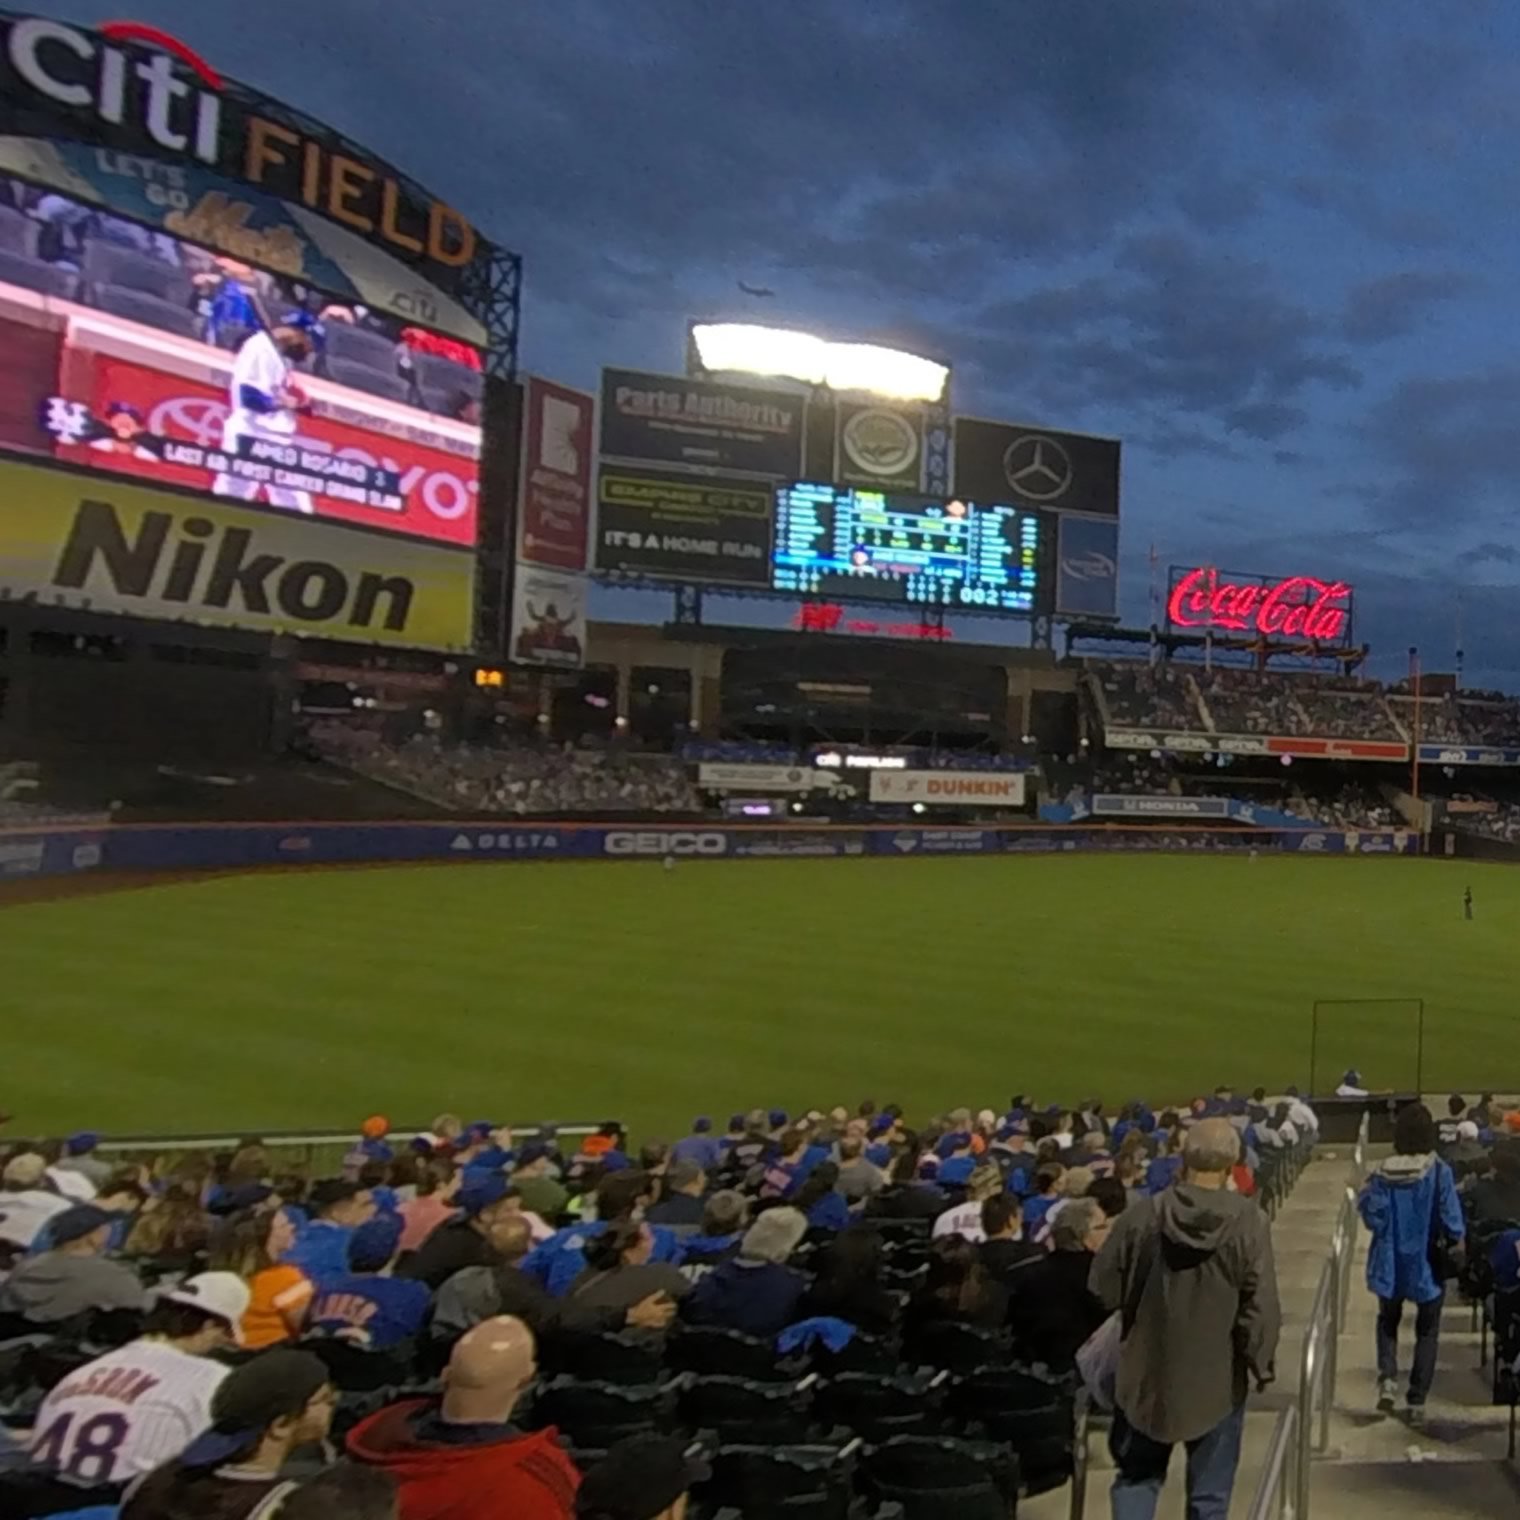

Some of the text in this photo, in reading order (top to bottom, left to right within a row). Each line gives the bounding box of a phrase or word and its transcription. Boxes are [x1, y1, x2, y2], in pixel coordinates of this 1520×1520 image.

[9, 19, 474, 267] citi FIELD
[97, 149, 186, 187] LET'S
[146, 182, 190, 209] GO
[615, 386, 793, 428] Parts Authority
[233, 459, 271, 482] FIRST
[301, 453, 367, 483] ROSARIO
[604, 530, 762, 559] IT'S A HOME RUN
[53, 499, 414, 633] Nikon
[1168, 566, 1353, 640] Coca-Cola
[926, 778, 1017, 797] DUNKIN'
[1138, 801, 1200, 812] HONDA
[478, 833, 559, 850] DELTA
[603, 831, 727, 855] GEICO
